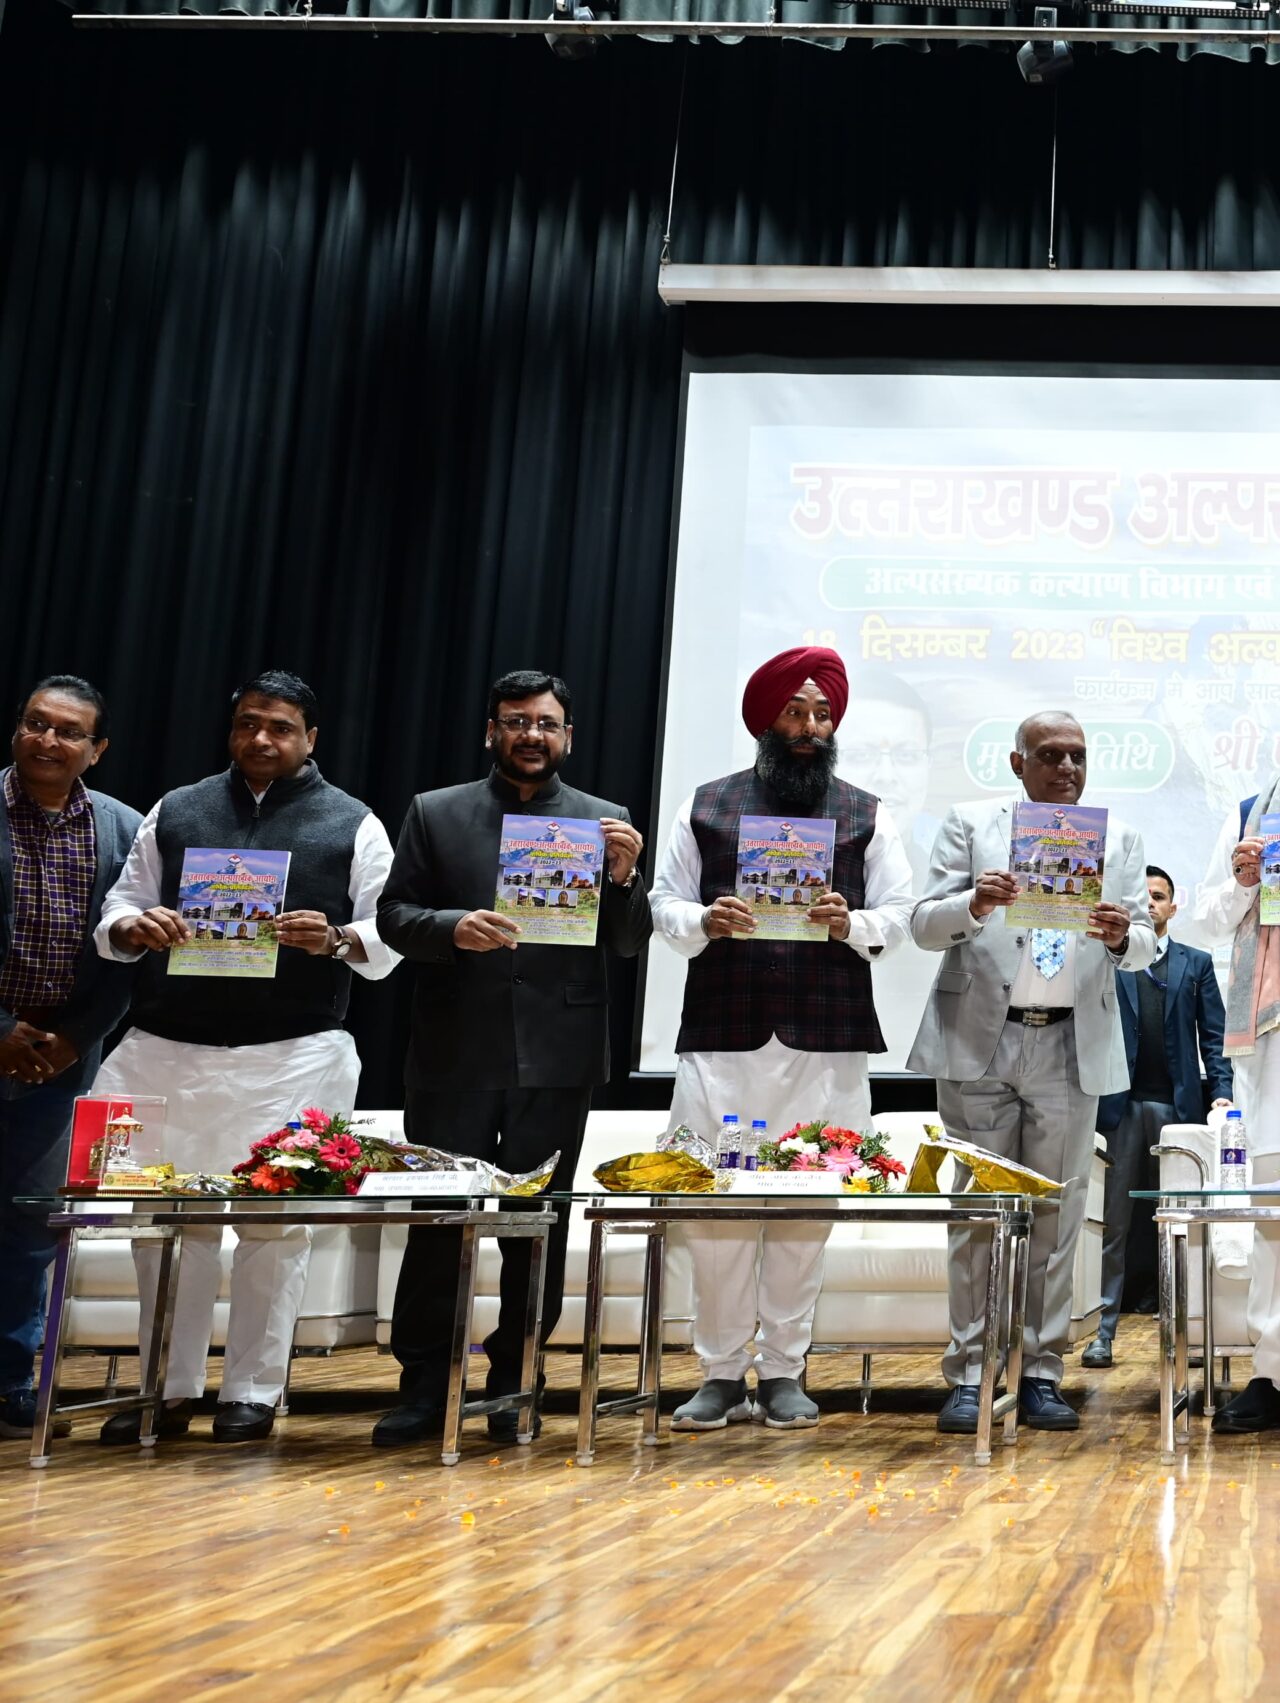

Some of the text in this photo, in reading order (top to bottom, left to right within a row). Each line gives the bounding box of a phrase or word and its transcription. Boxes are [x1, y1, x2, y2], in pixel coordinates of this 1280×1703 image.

[792, 464, 1120, 548] उत्तराखण्ड
[865, 562, 1021, 597] अल्पसंख्यक
[1029, 571, 1132, 599] कल्याण
[1139, 567, 1227, 601] विभाग
[1234, 571, 1273, 601] एवं
[859, 614, 992, 663] दिसम्बर
[1011, 630, 1085, 661] 2023
[1195, 677, 1236, 702] आप
[1213, 715, 1264, 776] श्री
